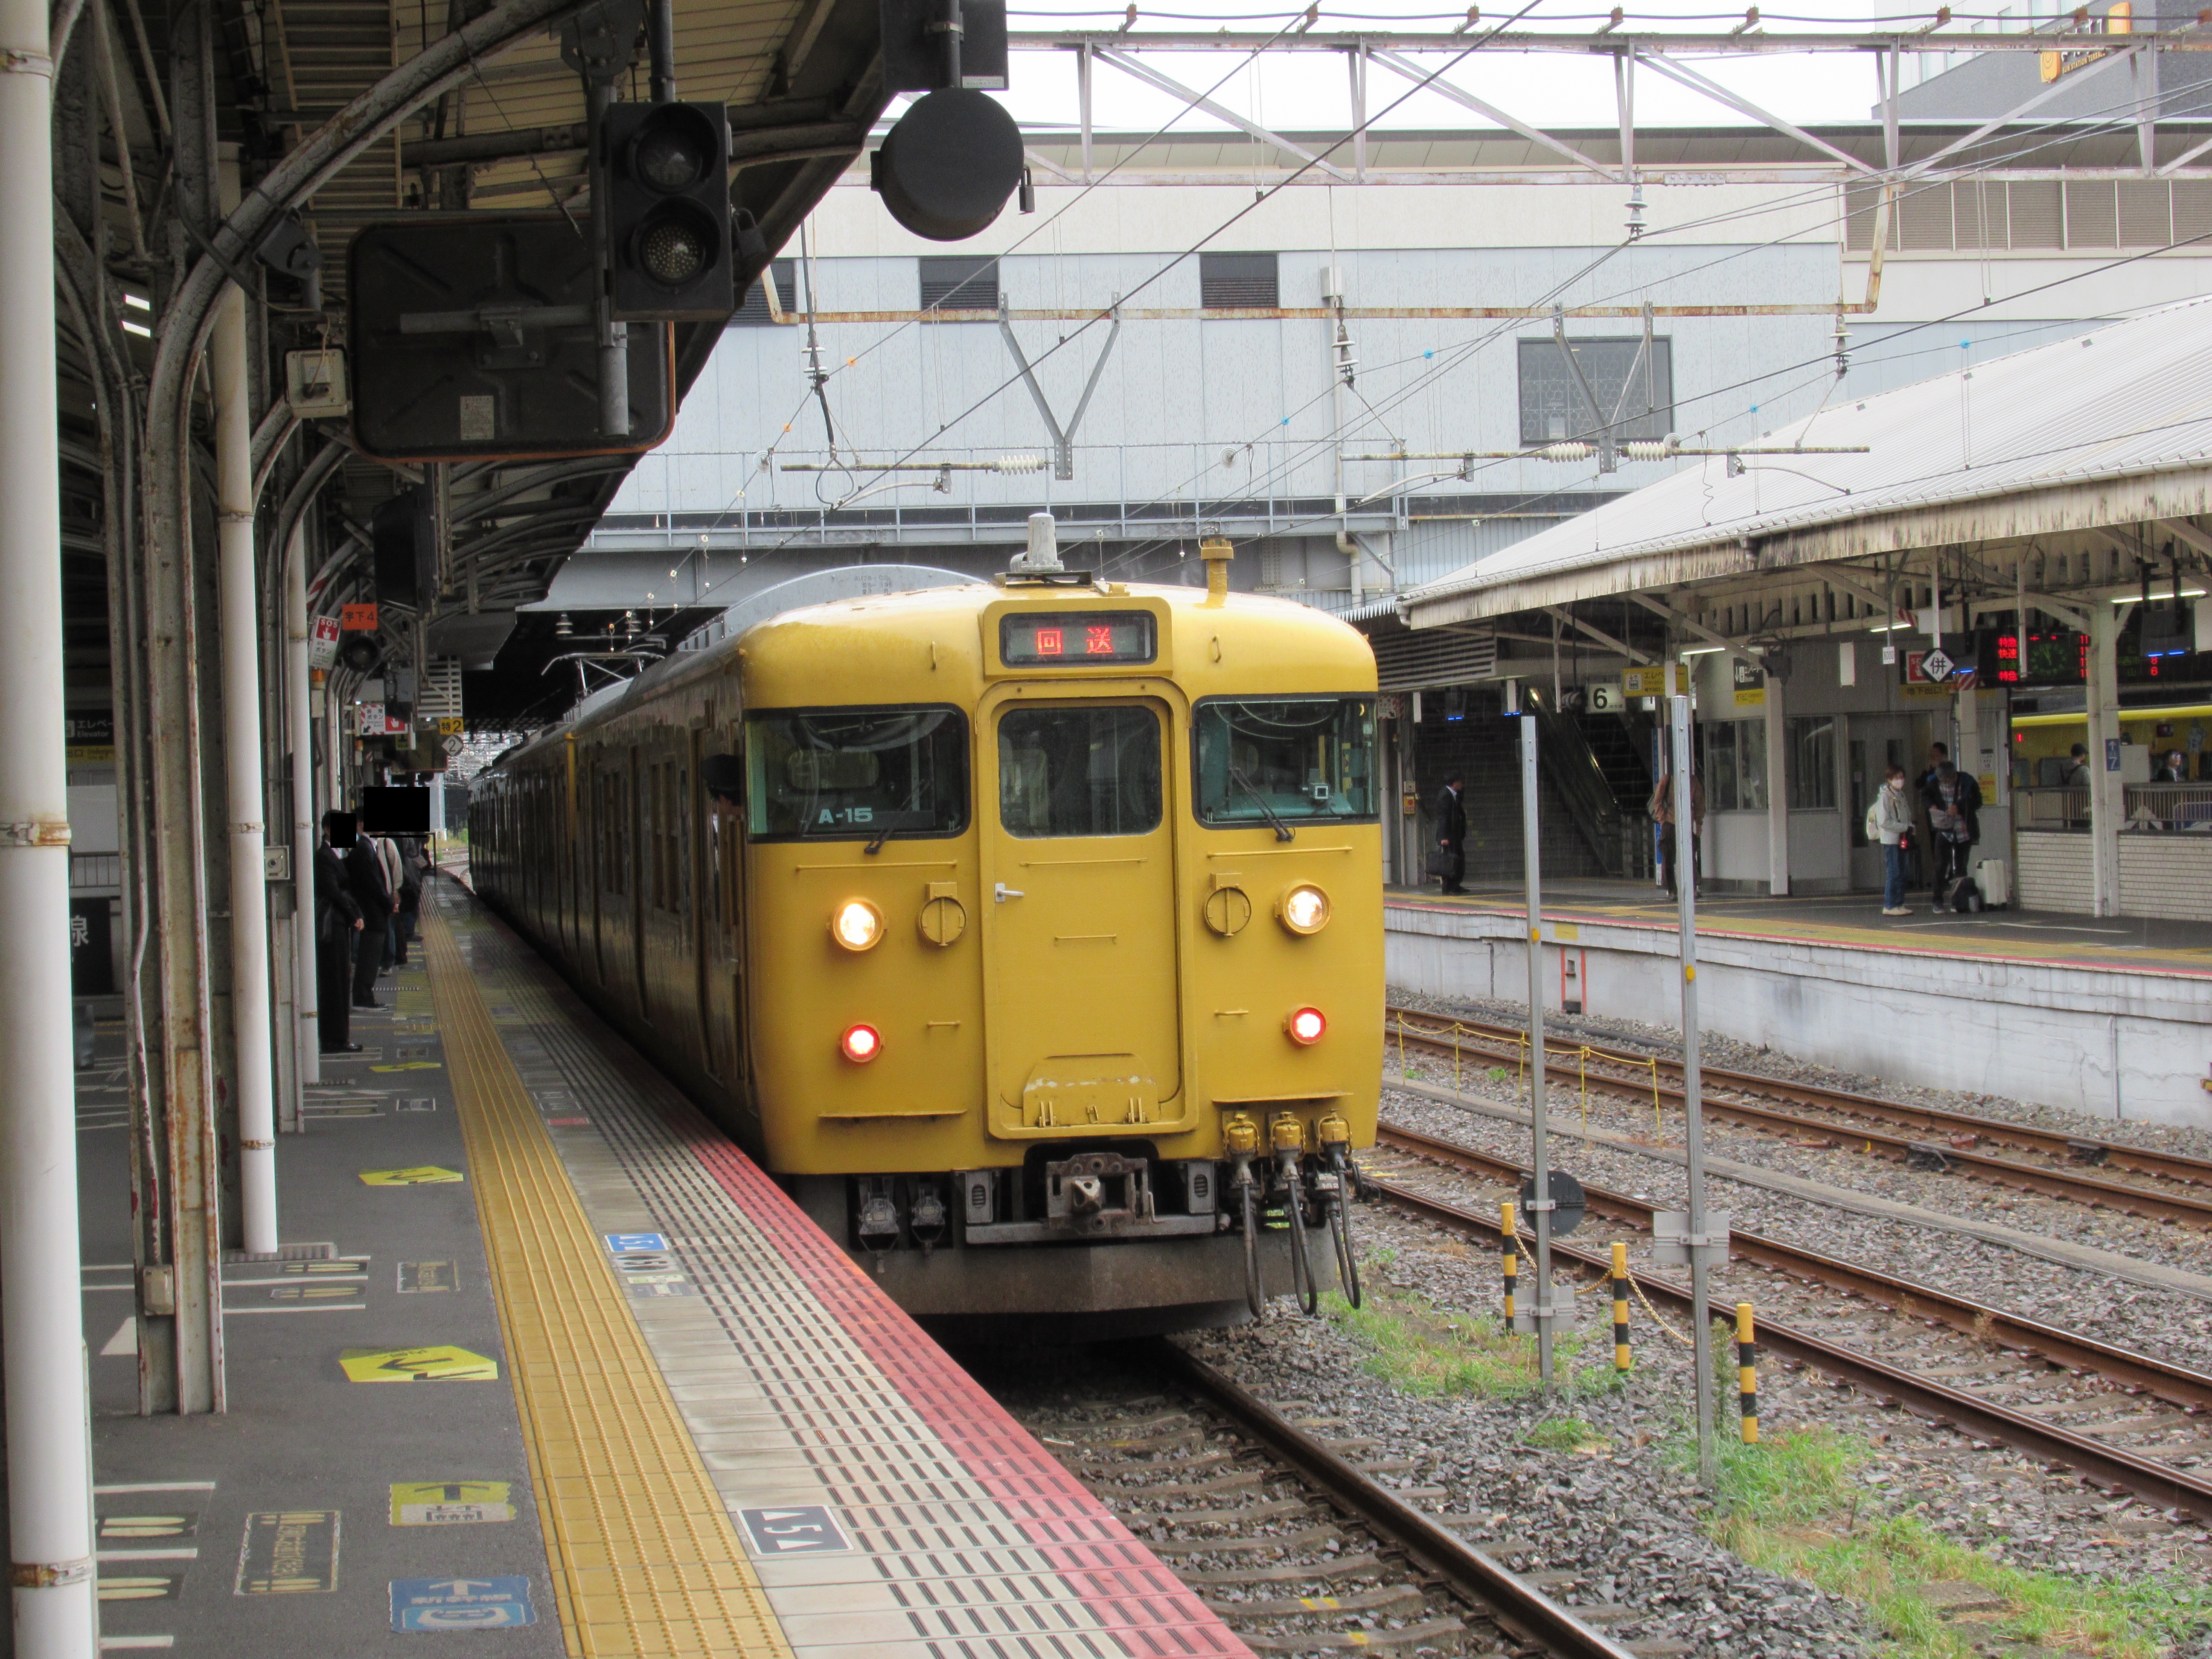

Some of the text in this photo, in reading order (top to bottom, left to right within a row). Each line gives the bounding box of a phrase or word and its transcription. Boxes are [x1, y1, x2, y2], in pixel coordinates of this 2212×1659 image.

[320, 619, 339, 629] SOS
[1037, 627, 1114, 655] 回送
[1930, 657, 1947, 675] 併
[1593, 687, 1607, 709] 6
[448, 739, 456, 751] 2
[2108, 757, 2117, 769] 7
[818, 807, 873, 824] A-15
